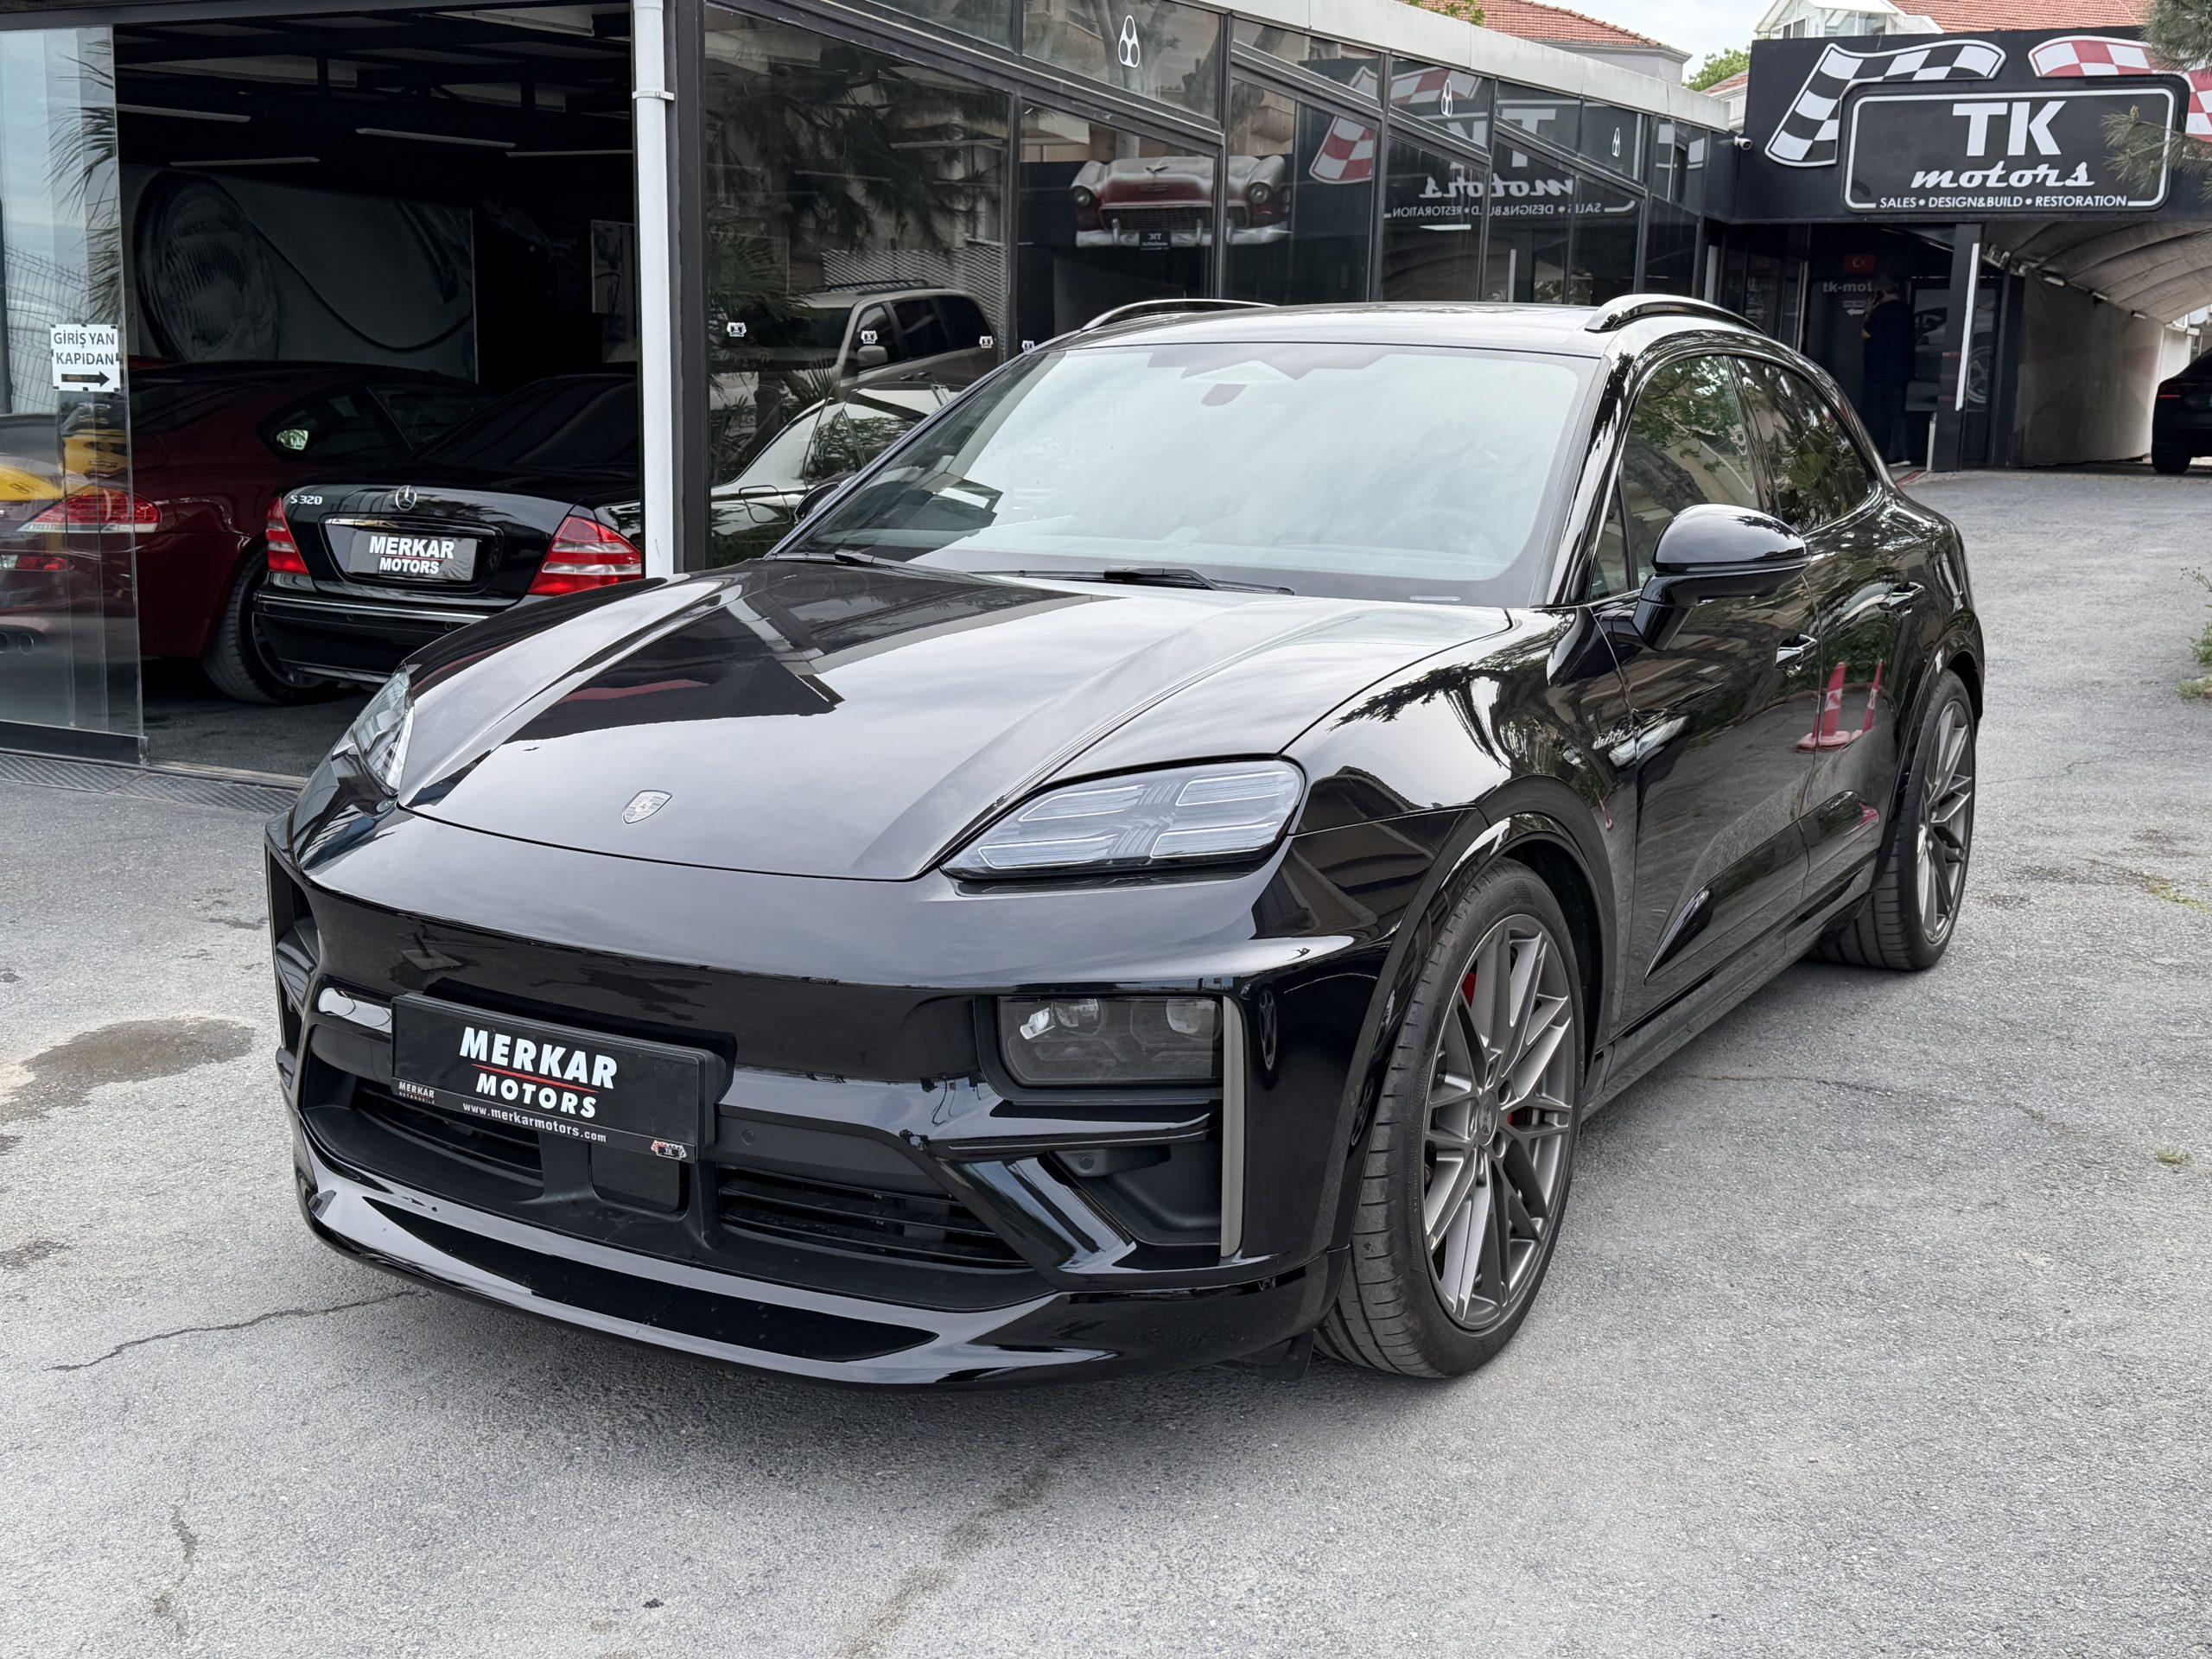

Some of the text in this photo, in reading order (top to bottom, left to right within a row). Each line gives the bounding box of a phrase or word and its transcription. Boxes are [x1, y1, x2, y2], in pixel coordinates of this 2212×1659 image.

[1953, 100, 2067, 156] TK
[1910, 161, 2095, 188] motors
[1879, 195, 2126, 208] SALES DESIGN&BUILD RESTORATION
[54, 330, 115, 348] GİRİŞ YAN
[56, 353, 114, 365] KAPIDAN
[290, 495, 323, 505] S 320
[369, 536, 455, 559] MERKAR
[379, 557, 440, 575] MOTORS
[459, 1027, 617, 1089] MERKAR
[398, 1081, 435, 1098] MERKAR
[475, 1072, 596, 1118] MOTORS
[462, 1103, 607, 1142] www.merkarmotors.com
